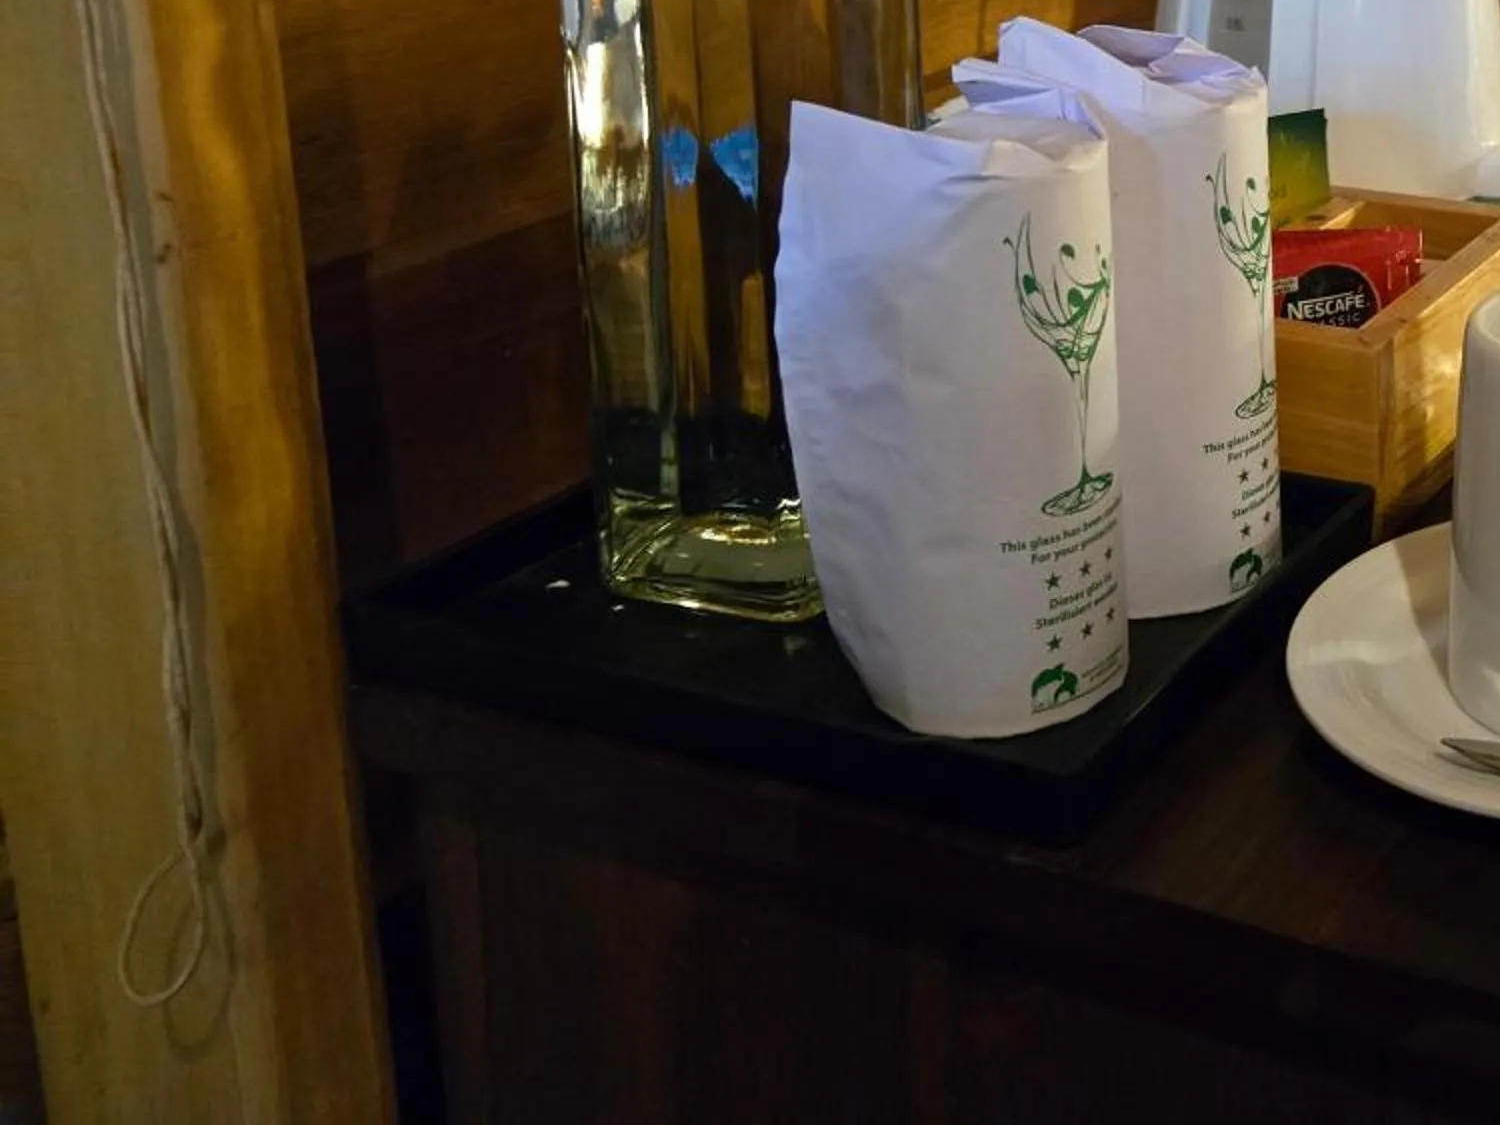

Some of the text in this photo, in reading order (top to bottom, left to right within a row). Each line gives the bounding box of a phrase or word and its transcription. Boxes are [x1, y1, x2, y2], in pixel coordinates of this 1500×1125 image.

[1287, 285, 1366, 320] NESCAFÉ
[1000, 541, 1026, 553] This
[1029, 534, 1061, 550] glass
[1063, 527, 1081, 539] has
[1031, 544, 1079, 564] For your
